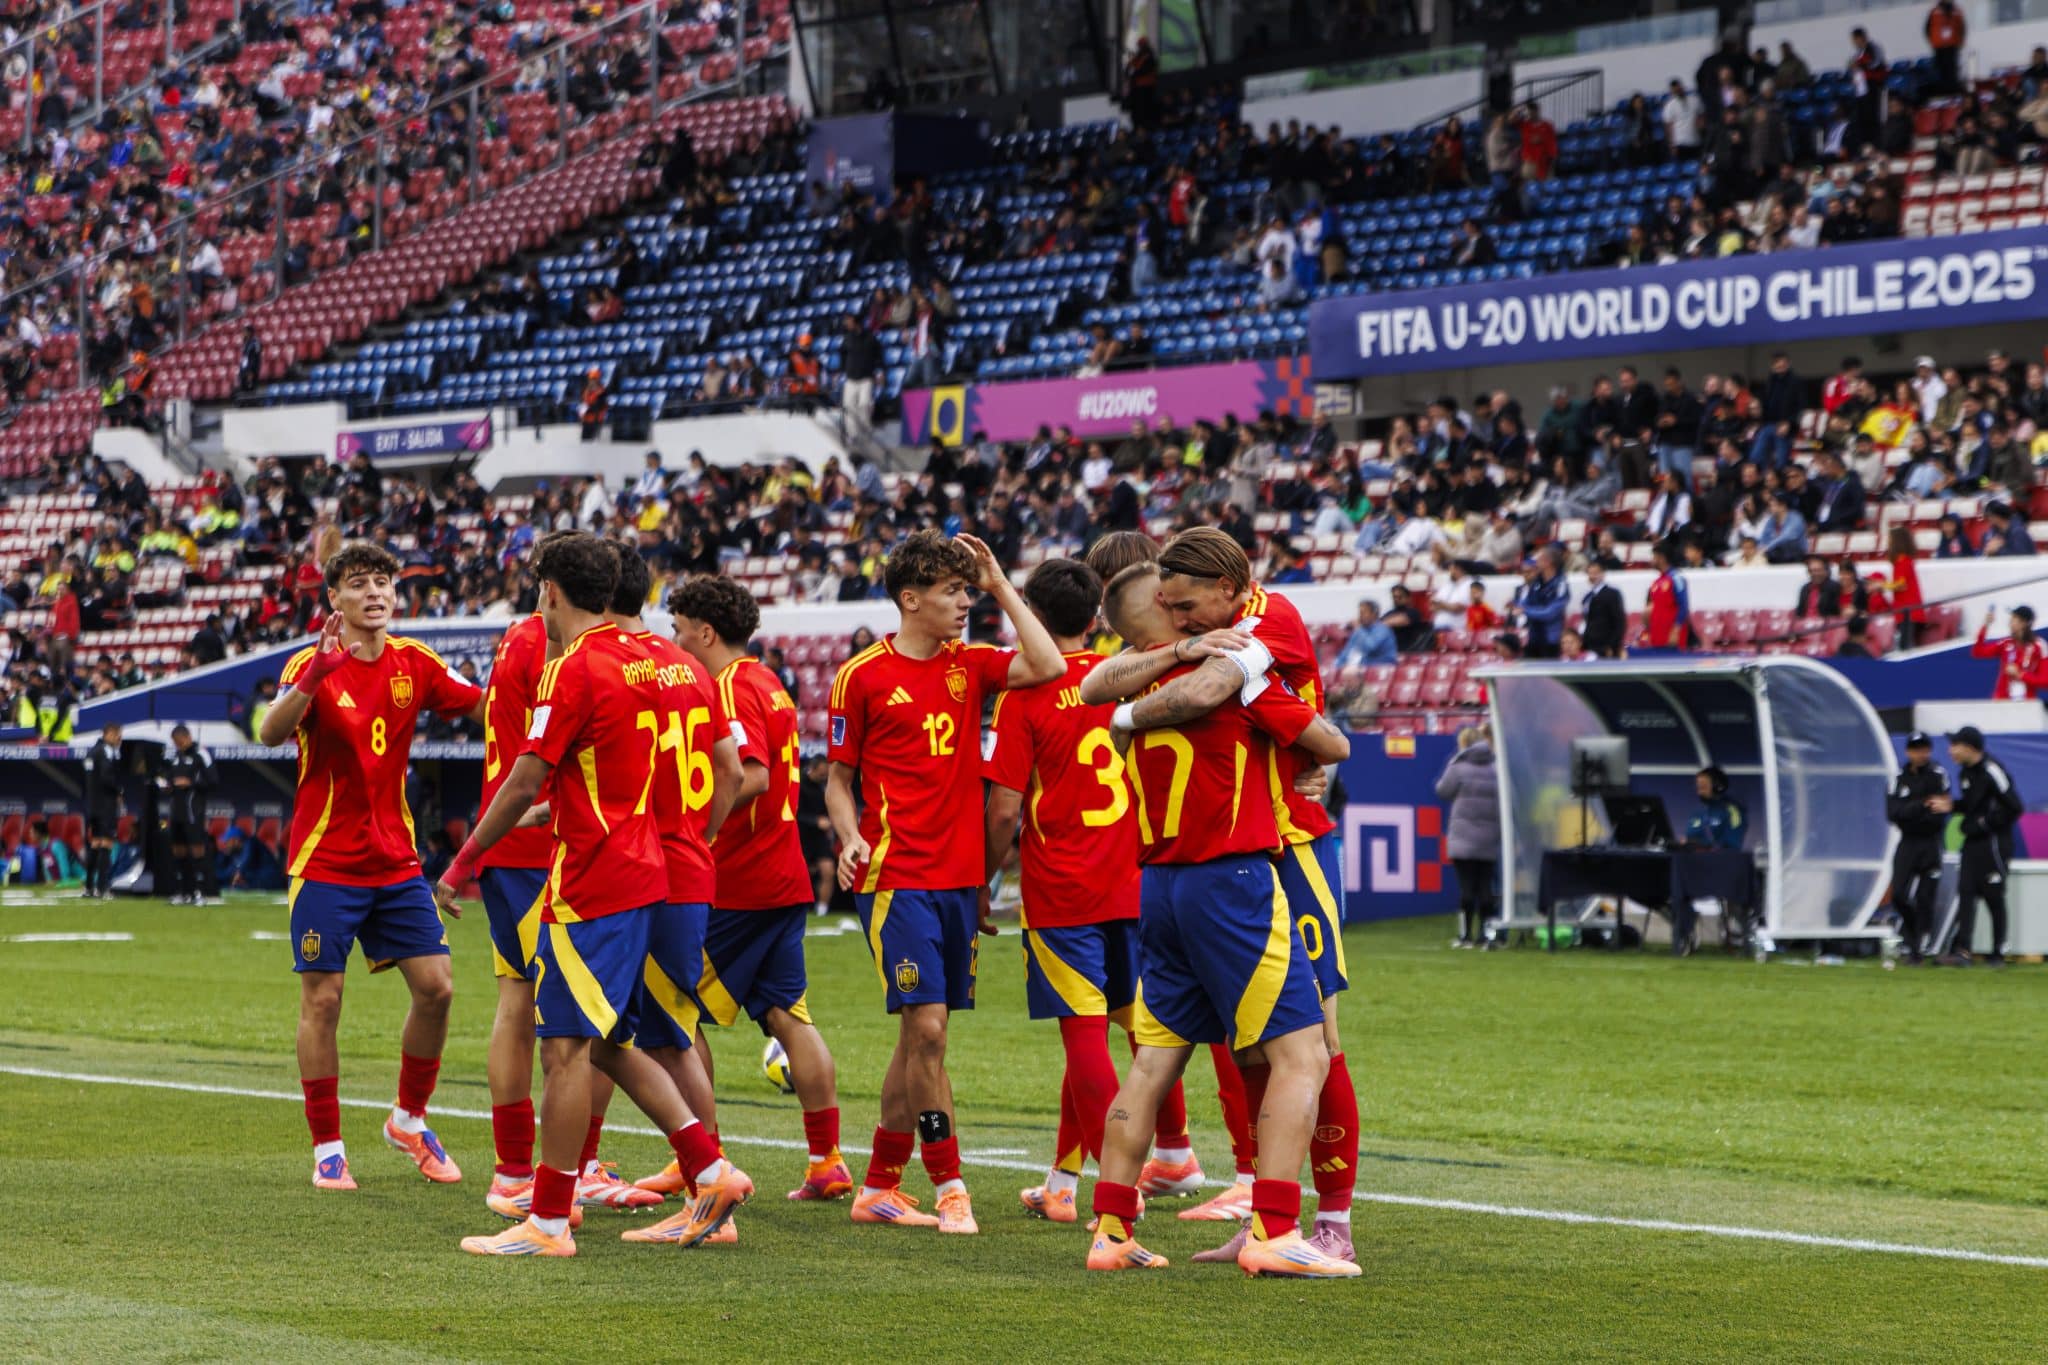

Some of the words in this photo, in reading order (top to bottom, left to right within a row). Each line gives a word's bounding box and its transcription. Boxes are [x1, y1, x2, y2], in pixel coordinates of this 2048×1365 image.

[1358, 306, 1437, 358] FIFA
[1441, 297, 1526, 350] U-20
[1530, 283, 1671, 342] WORLD
[1676, 275, 1761, 329] CUP
[1766, 260, 1905, 322] CHILE
[1078, 386, 1158, 420] #U20WC
[375, 431, 399, 453] EXIT
[407, 427, 444, 450] SALIDA
[371, 716, 387, 756] 8
[922, 712, 955, 756] 12
[658, 706, 714, 815] 16
[1077, 727, 1130, 827] 3
